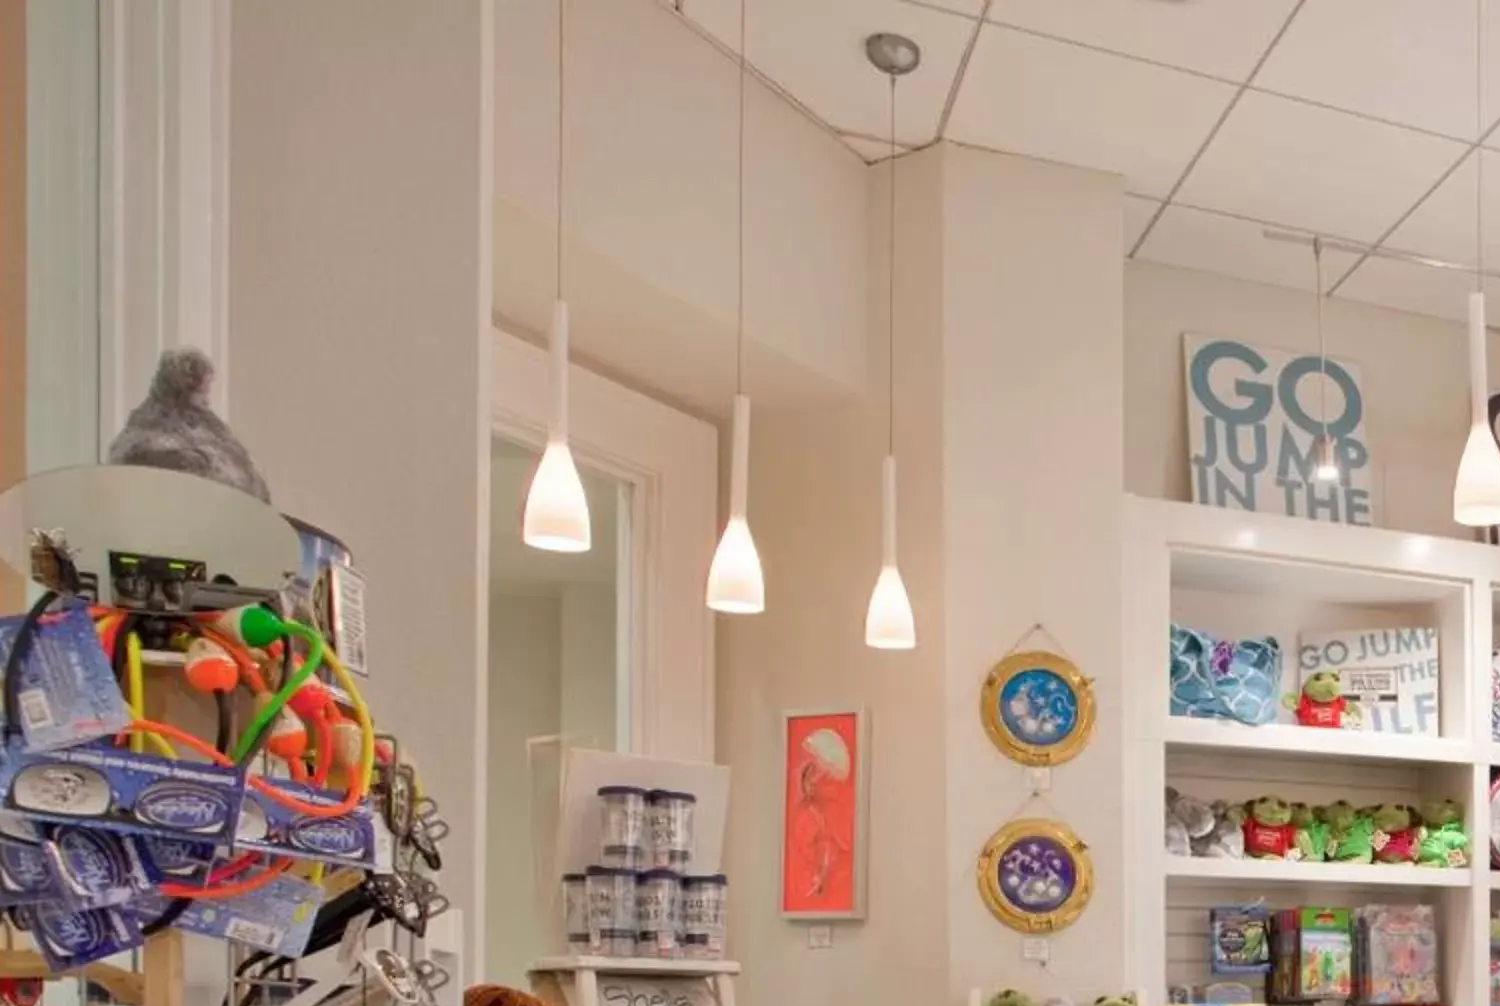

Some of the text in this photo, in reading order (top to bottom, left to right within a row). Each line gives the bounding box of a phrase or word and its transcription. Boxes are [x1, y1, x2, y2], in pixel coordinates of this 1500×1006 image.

[1190, 340, 1362, 437] GO
[1193, 415, 1367, 487] JUMP
[1197, 464, 1371, 528] IN THE
[1299, 627, 1436, 670] GO JUMP
[1397, 658, 1437, 683] THE
